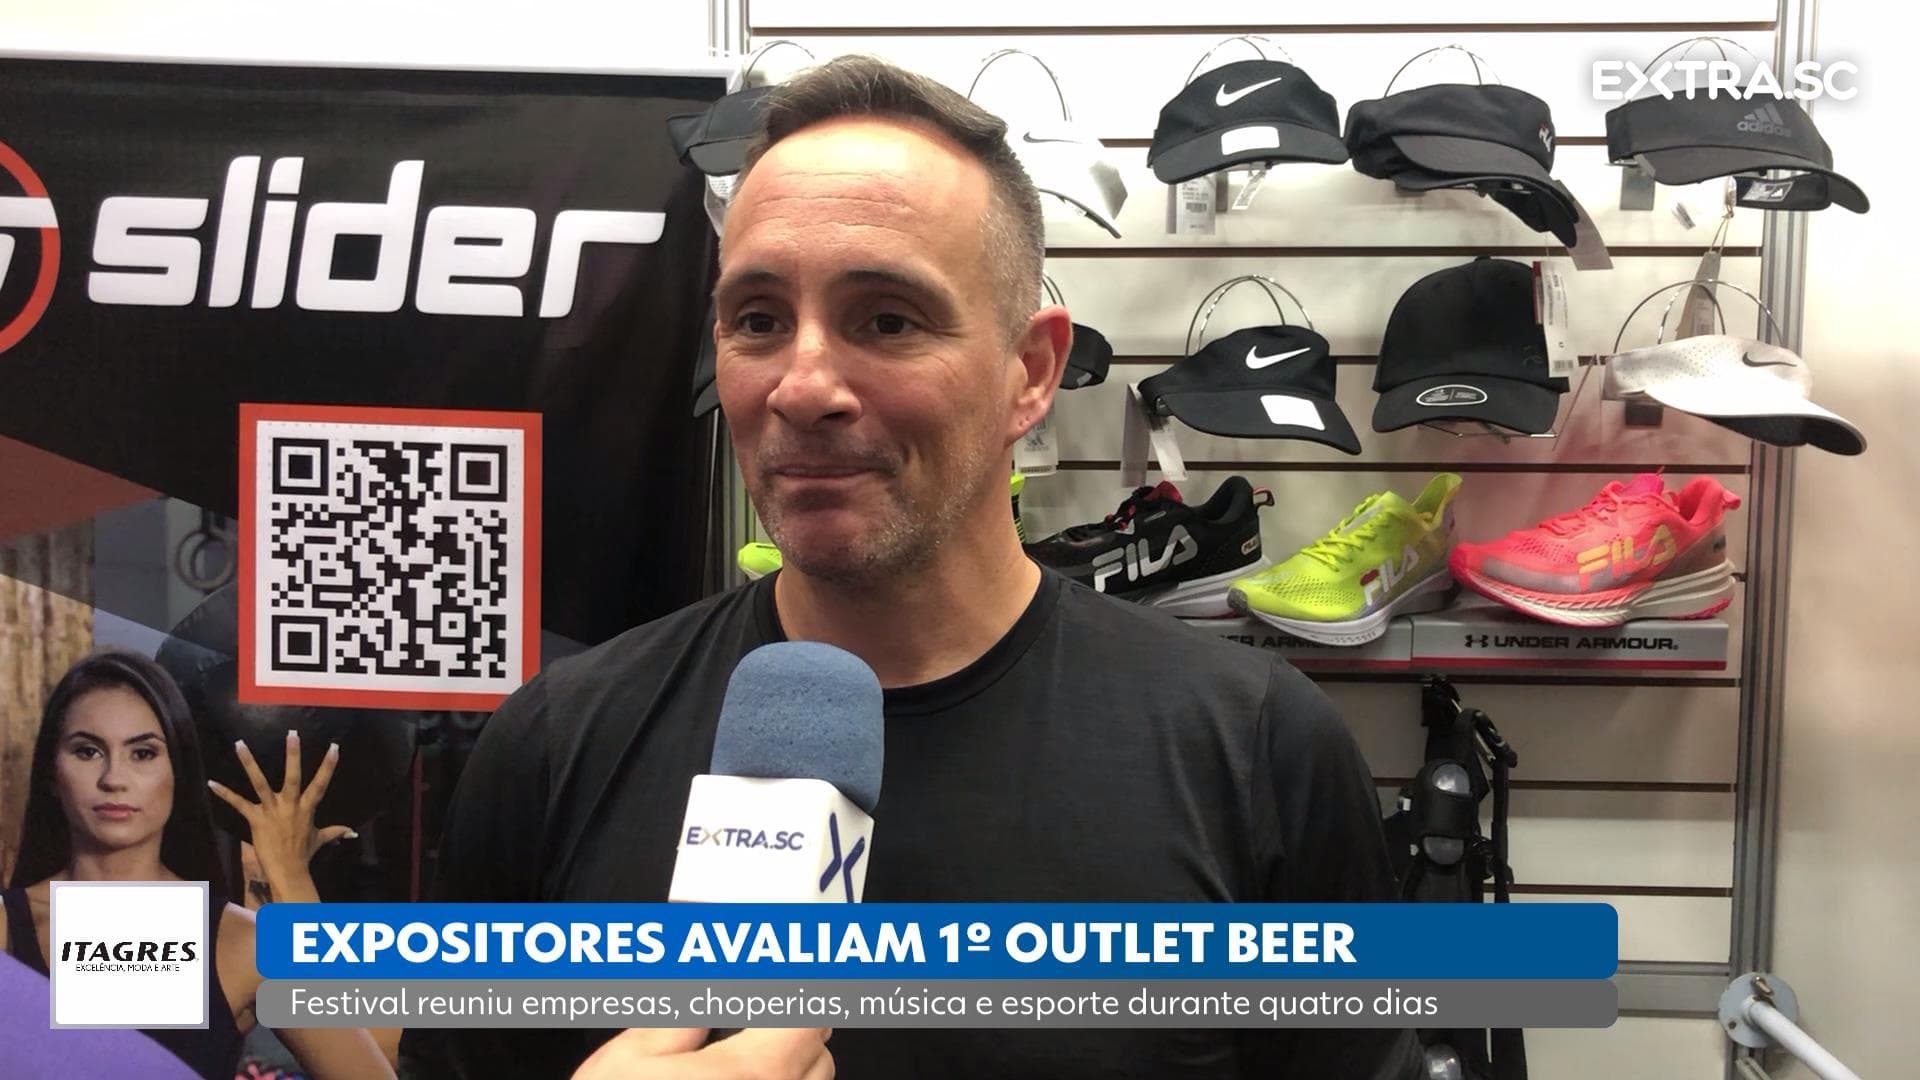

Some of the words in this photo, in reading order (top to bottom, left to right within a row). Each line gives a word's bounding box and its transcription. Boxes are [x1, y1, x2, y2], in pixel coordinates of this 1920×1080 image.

[1737, 121, 1792, 137] adidas
[88, 155, 667, 318] slider
[1092, 524, 1198, 593] FILA
[1359, 543, 1420, 607] FILA
[1577, 523, 1677, 592] FILA
[1494, 635, 1570, 648] UNDER
[686, 826, 805, 851] EXTRA.SC
